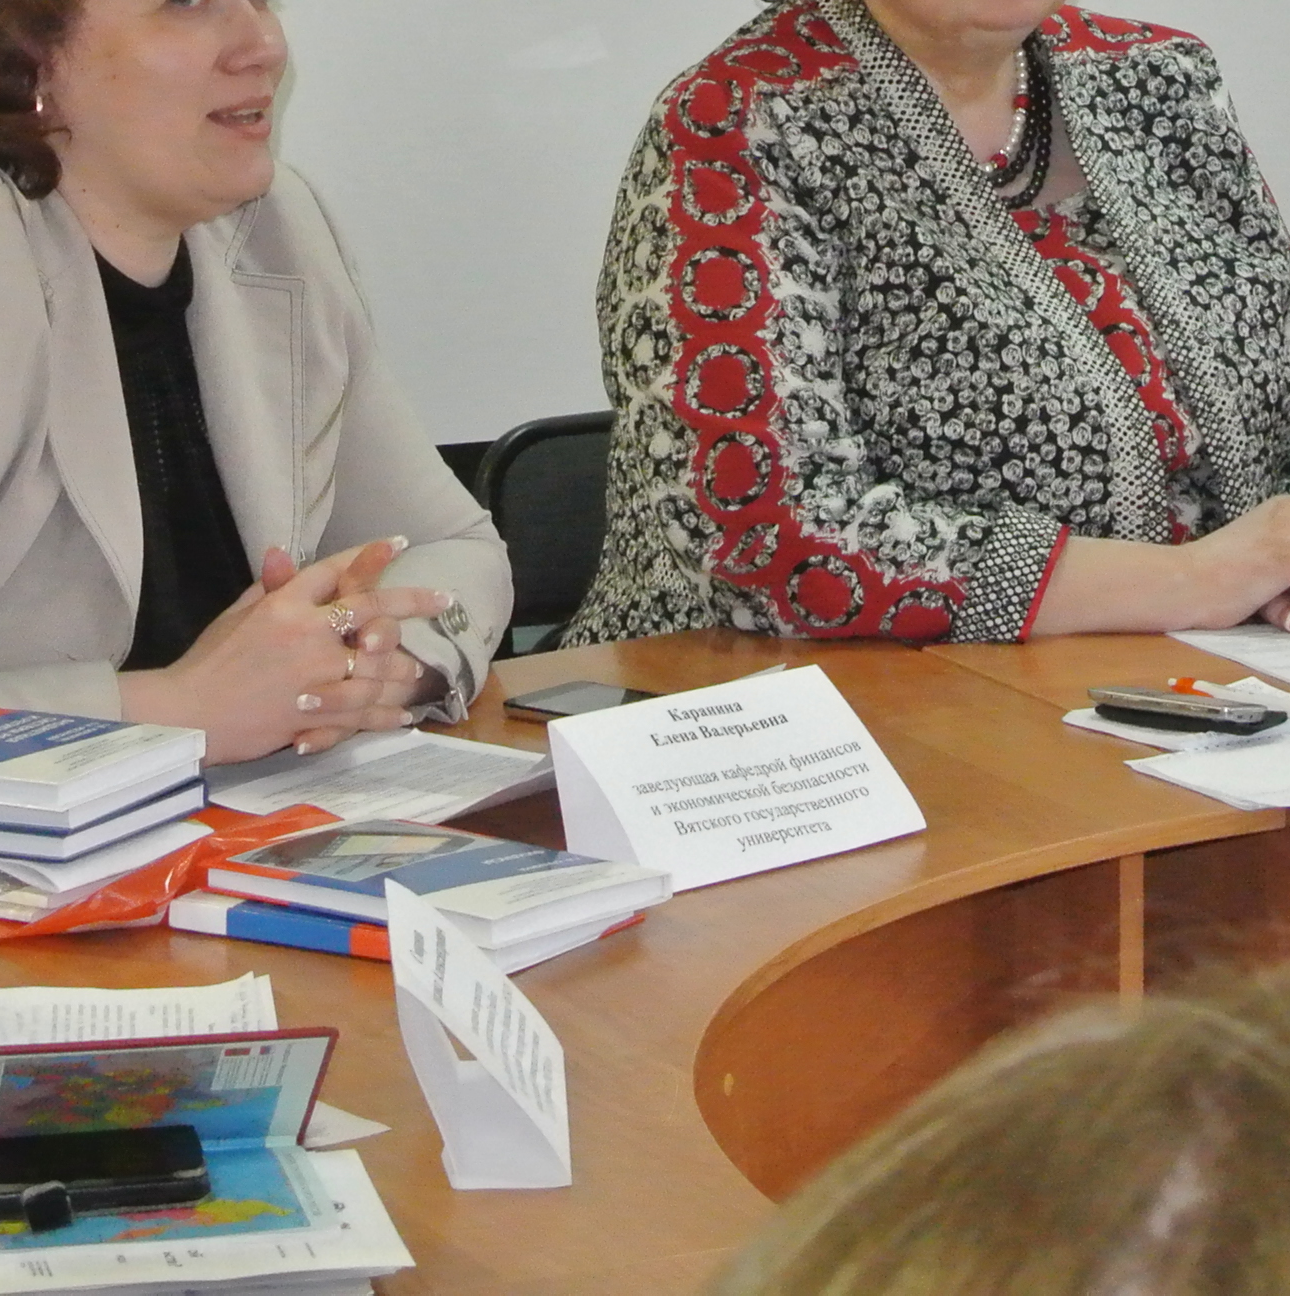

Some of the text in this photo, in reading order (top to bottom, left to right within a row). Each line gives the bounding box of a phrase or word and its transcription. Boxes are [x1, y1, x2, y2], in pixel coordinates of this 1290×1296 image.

[650, 712, 789, 747] Елена Валерьевна
[667, 700, 743, 722] Каранина
[632, 739, 861, 795] заведующая кафедрой финансов
[664, 783, 770, 813] экономической
[772, 762, 870, 792] безопасности
[674, 785, 870, 836] Вятского государственного
[736, 820, 831, 852] университета
